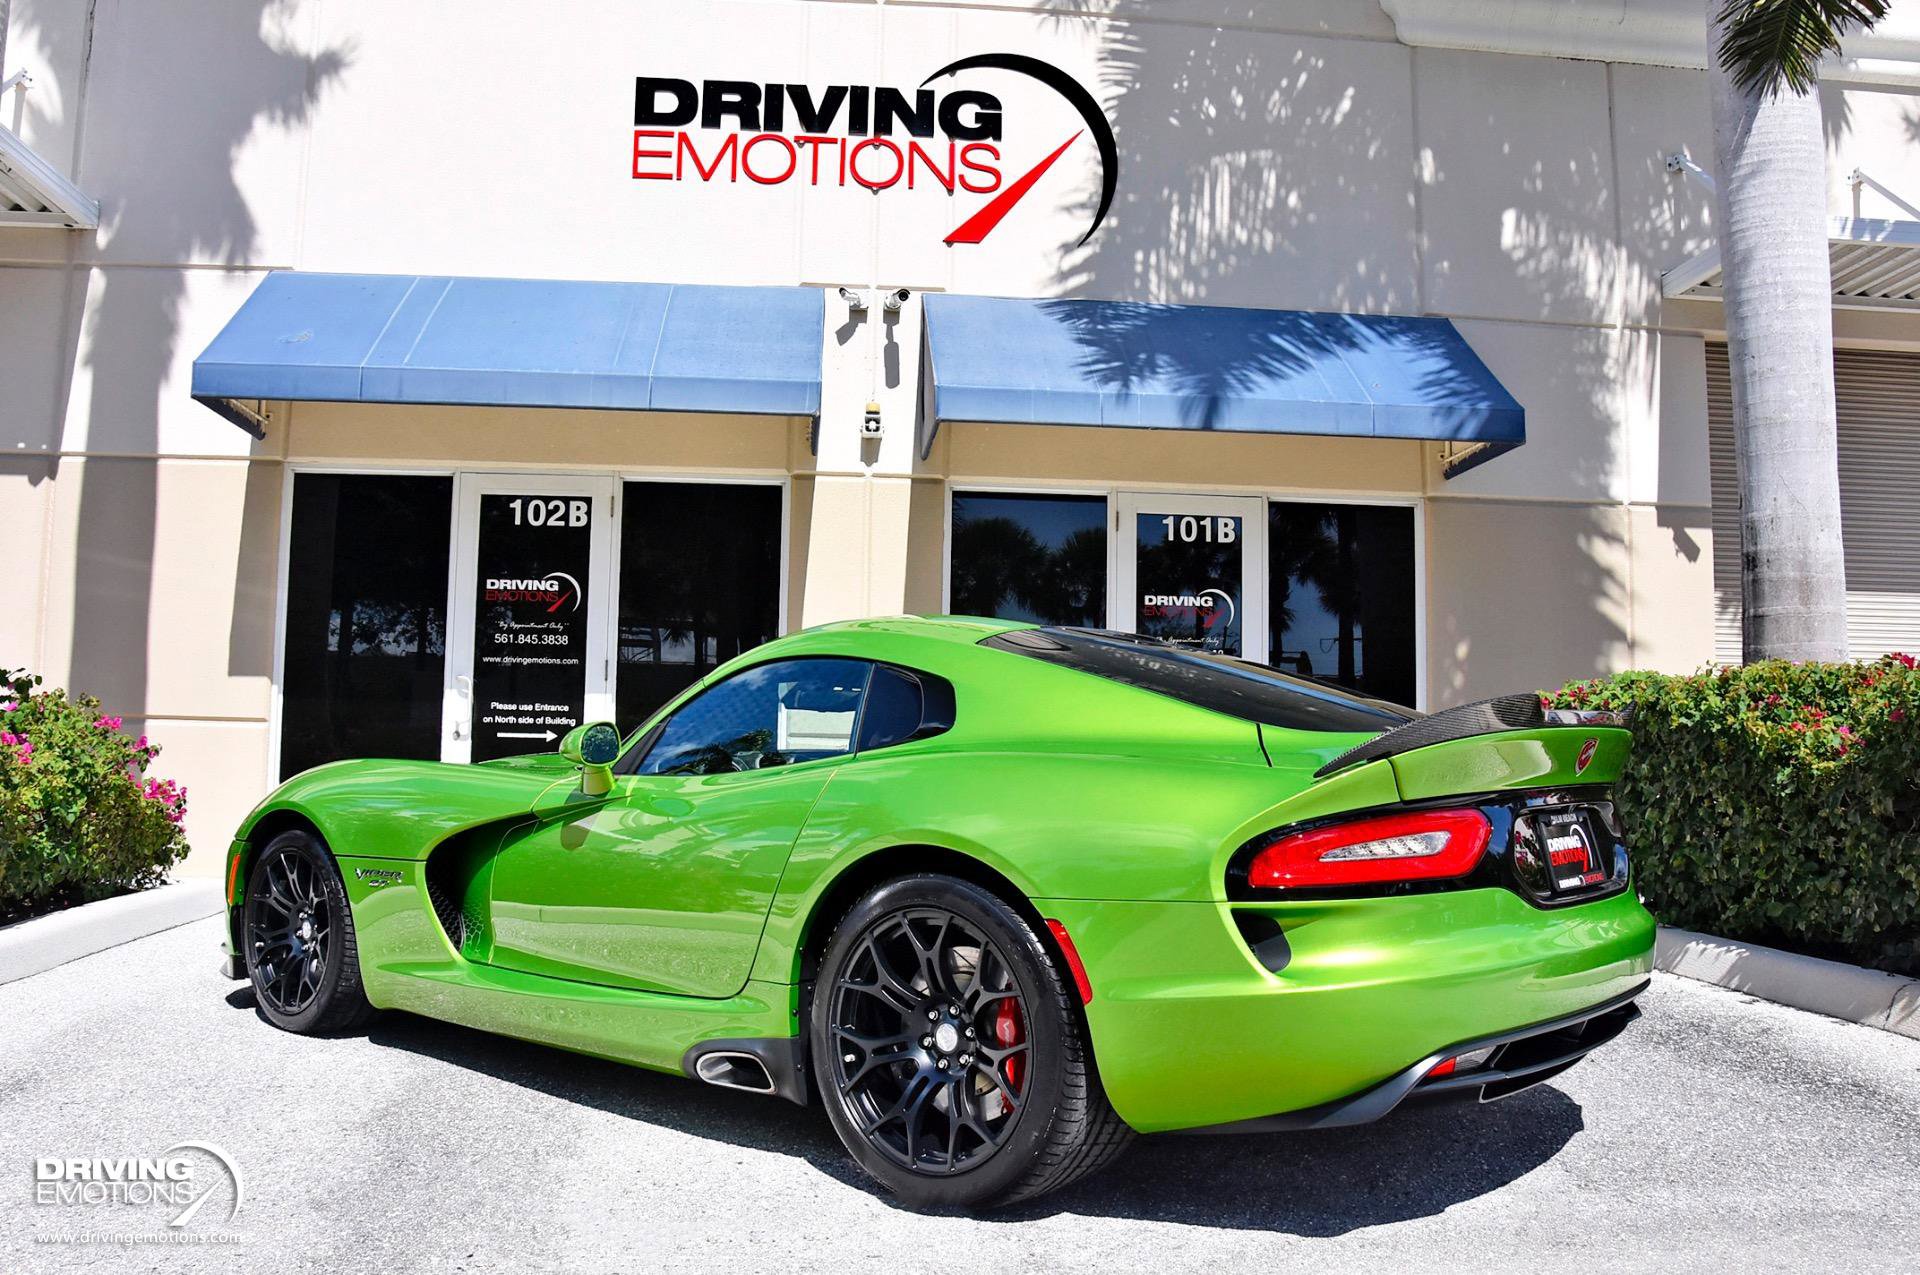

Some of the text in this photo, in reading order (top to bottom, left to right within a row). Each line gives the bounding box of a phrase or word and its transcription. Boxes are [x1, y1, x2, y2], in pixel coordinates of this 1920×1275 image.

[634, 77, 1002, 142] DRIVING
[632, 130, 1001, 194] EMOTIONS
[509, 498, 588, 528] 102B
[1162, 515, 1236, 543] 101B
[486, 579, 559, 591] DRIVING
[485, 590, 559, 602] EMOTIONS
[1144, 595, 1213, 607] DRIVING
[494, 633, 569, 646] 561.845.3838
[482, 656, 579, 666] www.drivingemotions.com
[490, 702, 570, 712] Please use Entrance
[482, 715, 577, 727] on North side of Building
[1547, 835, 1582, 852] DRIVING
[1551, 848, 1585, 866] EMOTIONS
